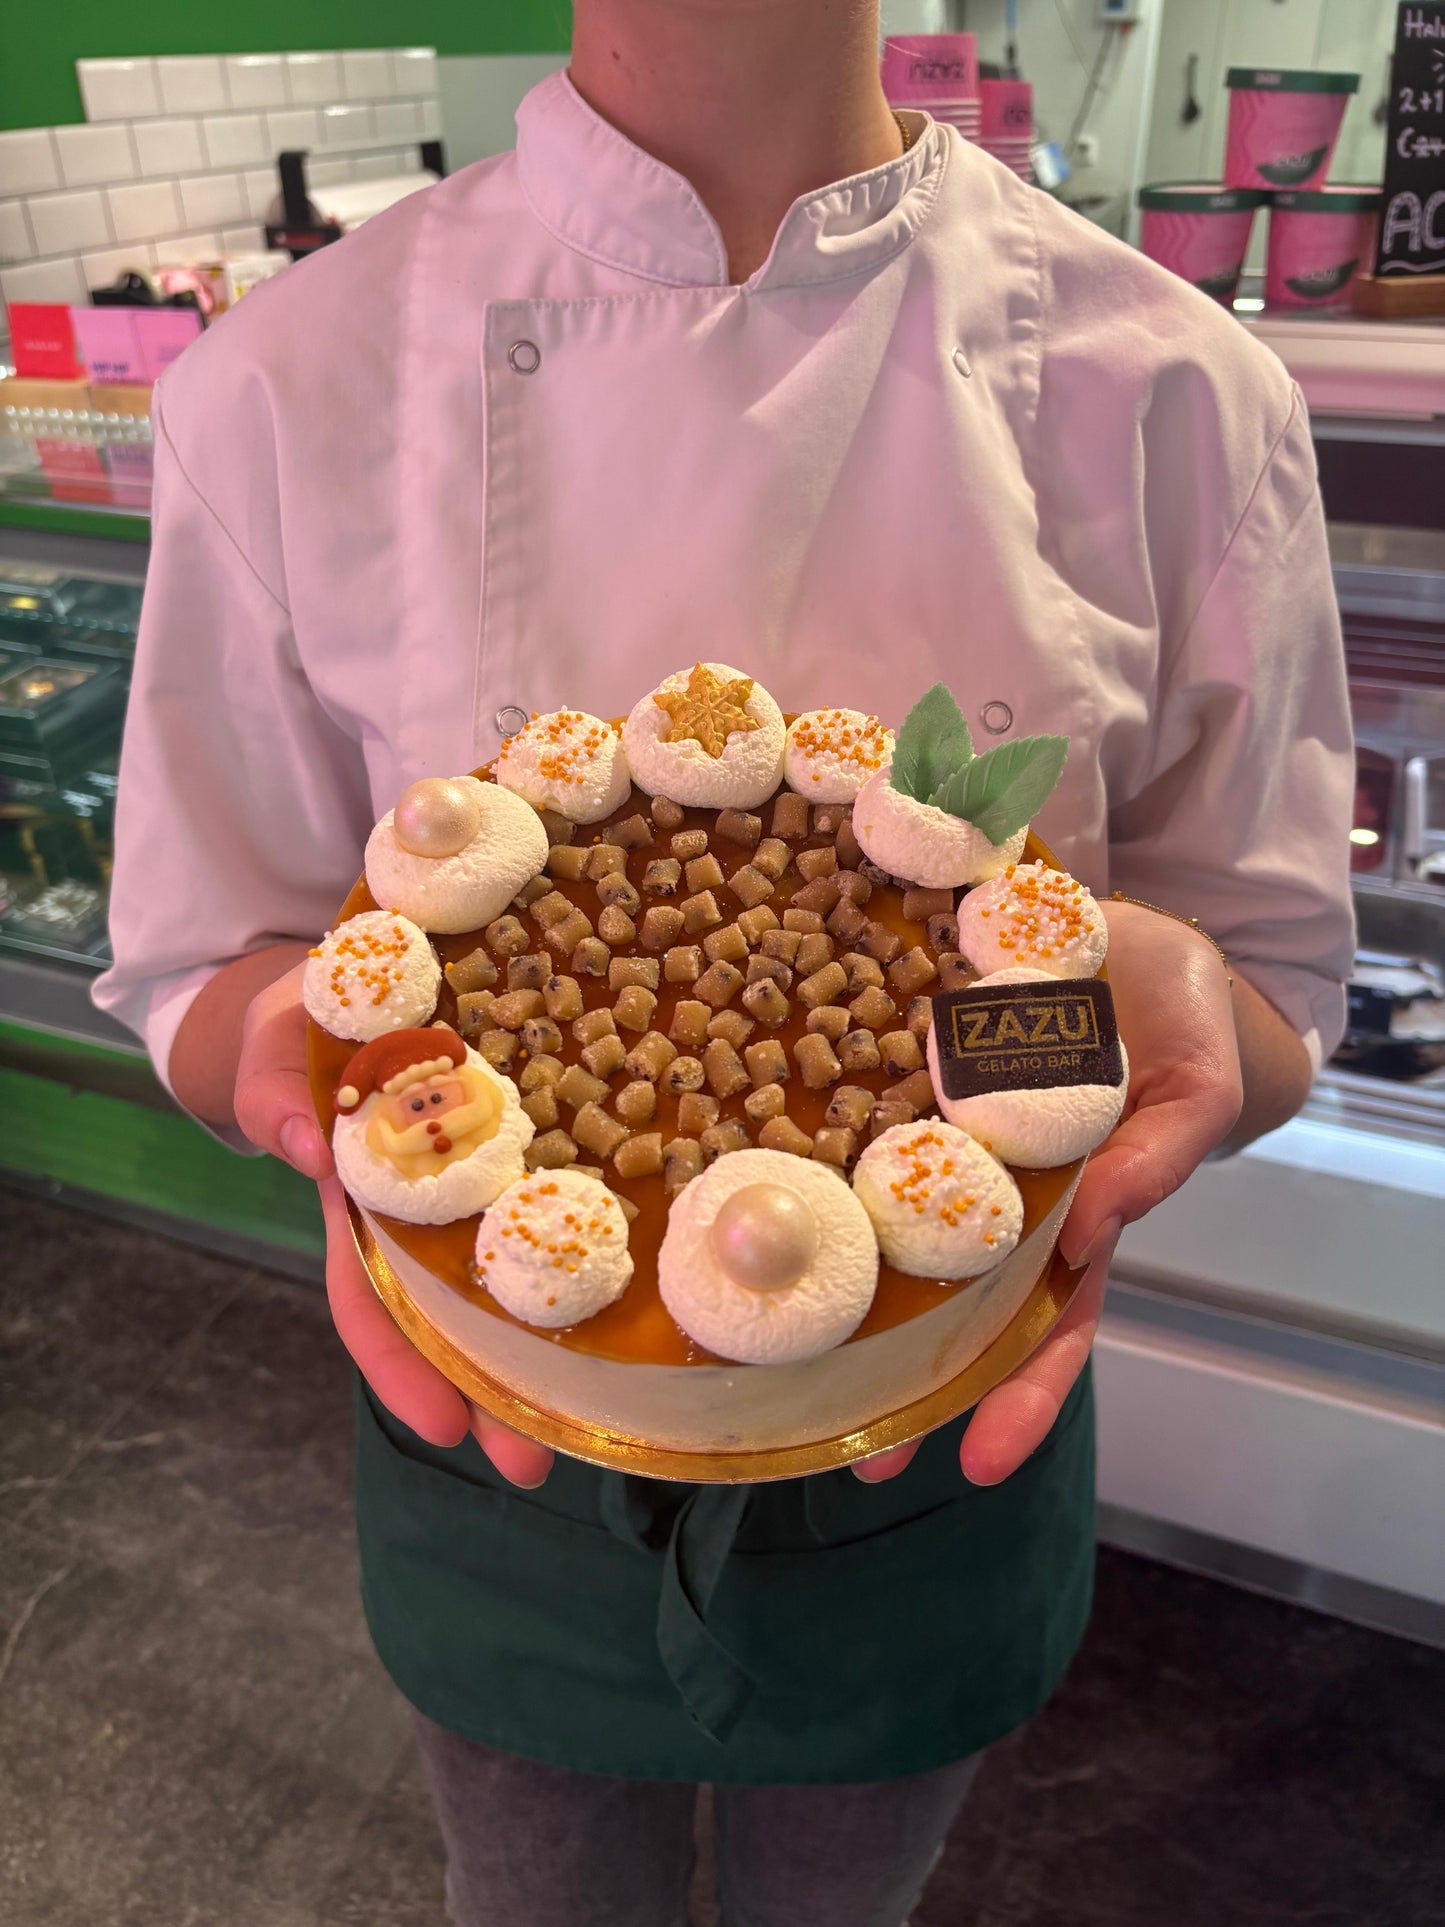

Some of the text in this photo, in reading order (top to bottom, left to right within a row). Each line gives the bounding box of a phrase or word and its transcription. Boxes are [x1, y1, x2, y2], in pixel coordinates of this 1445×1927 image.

[961, 1005, 1089, 1048] ZAZU
[976, 1053, 1082, 1073] GELATO BAR
